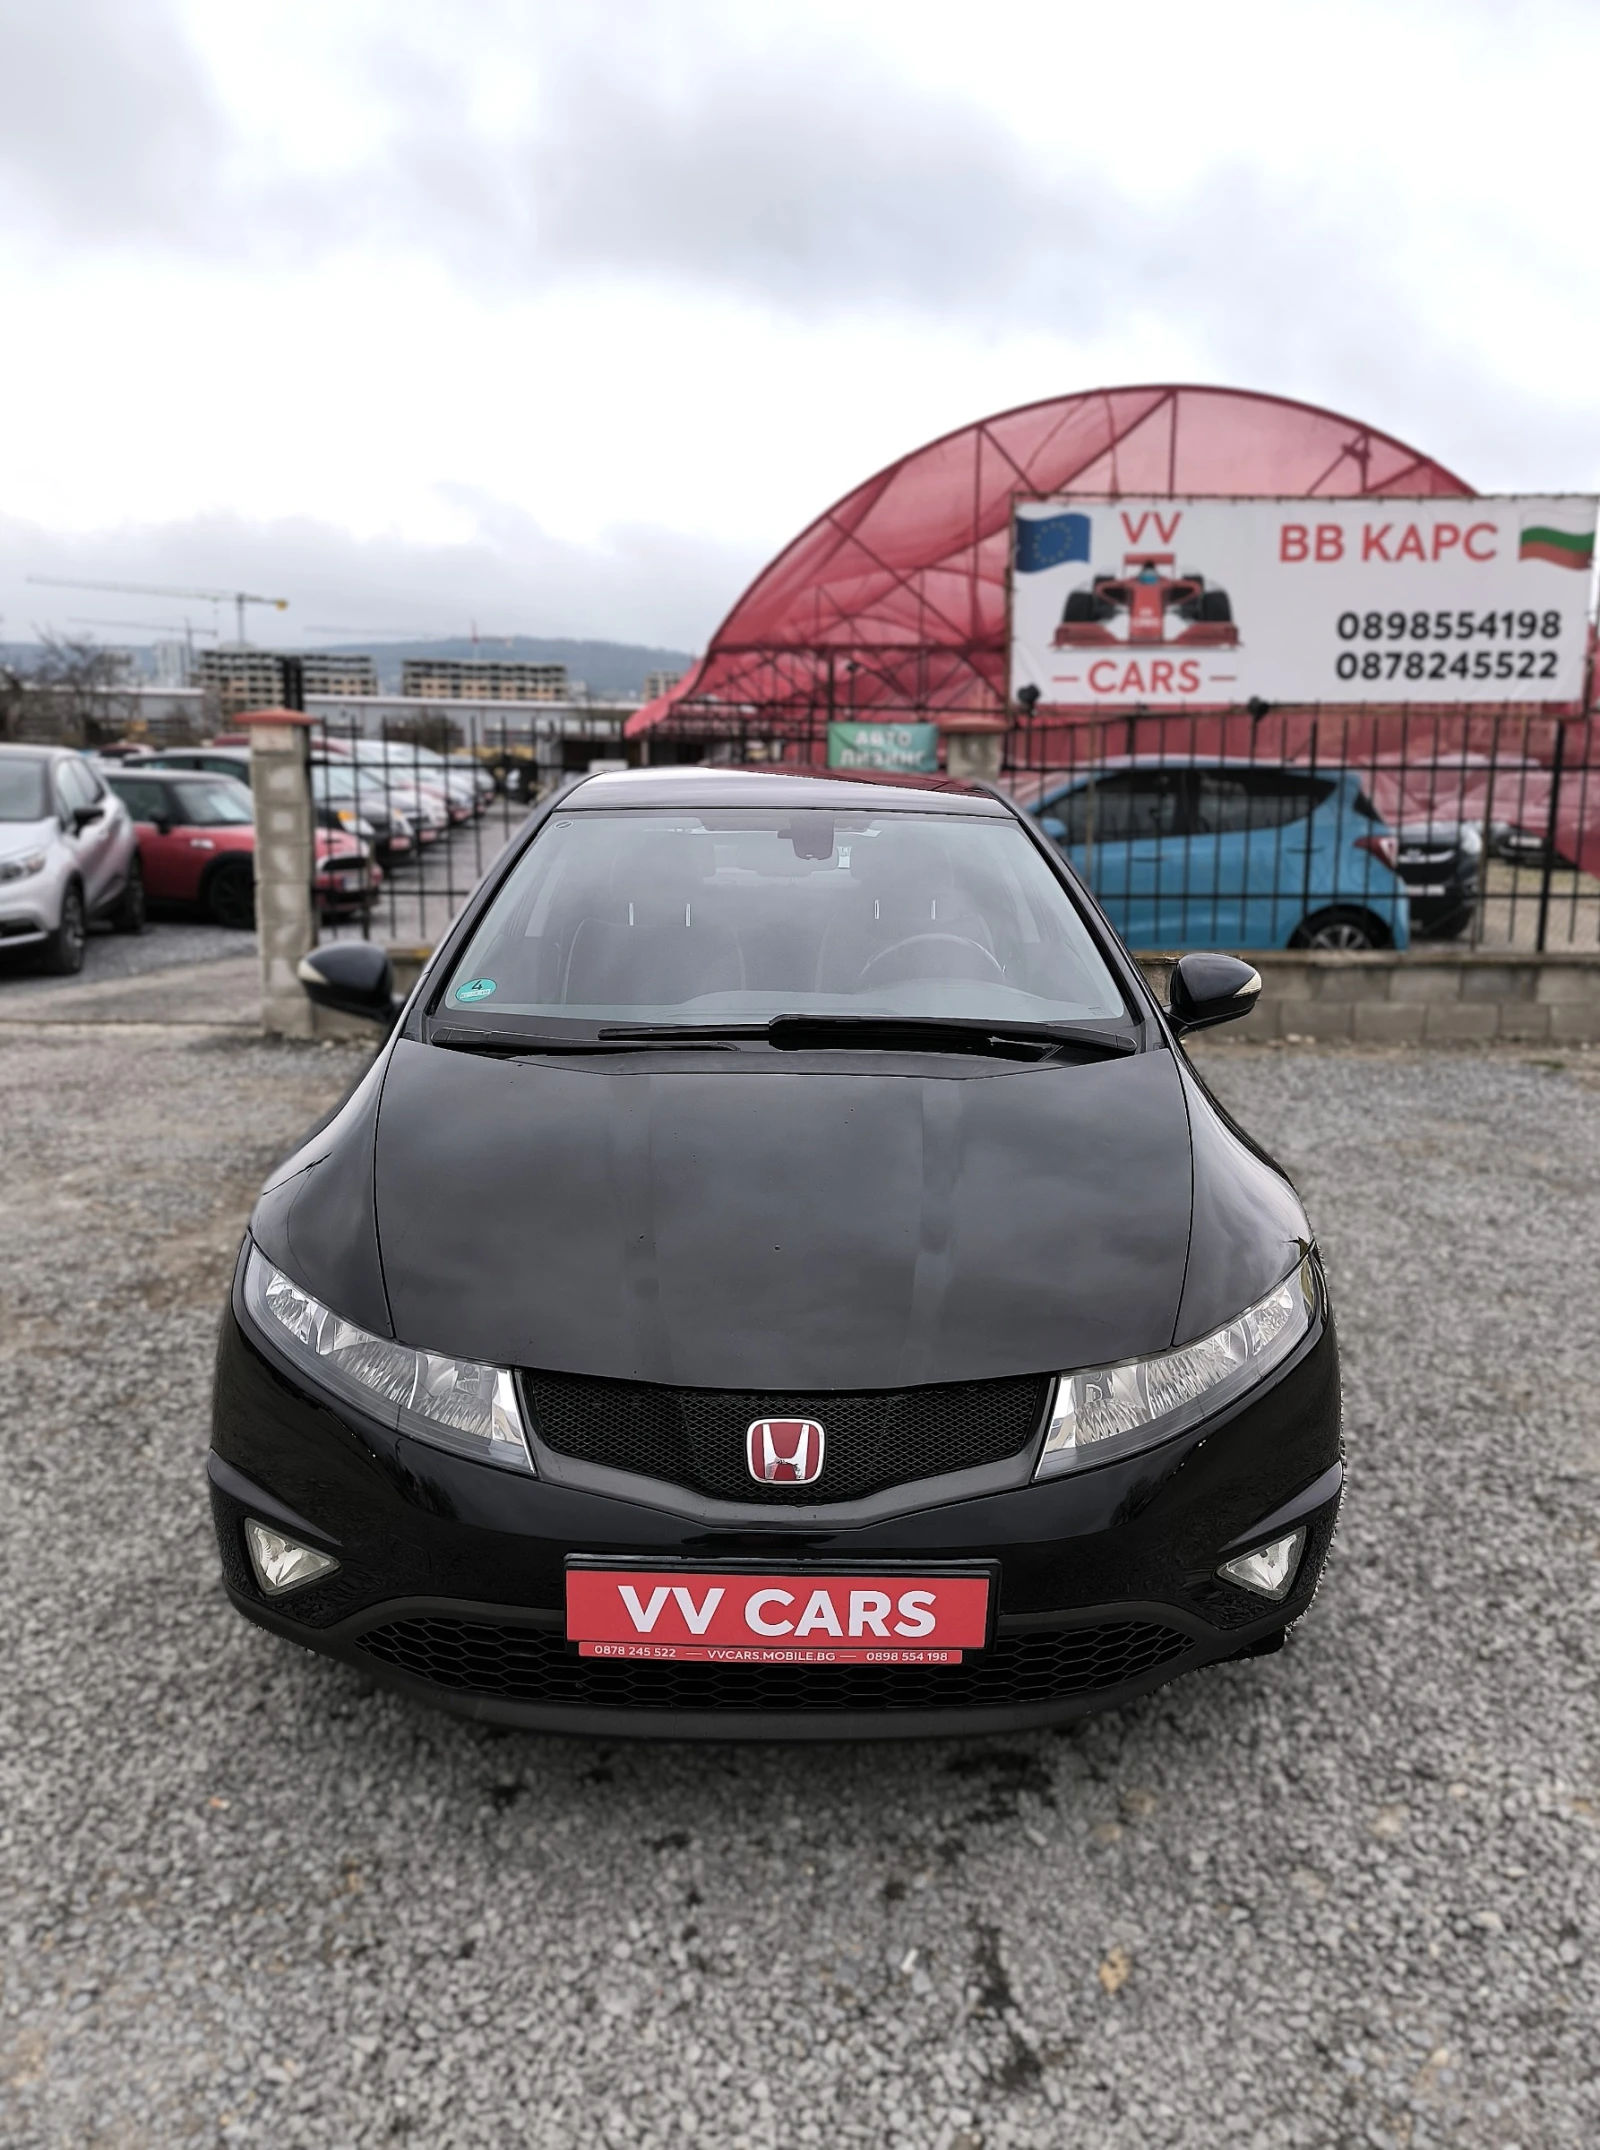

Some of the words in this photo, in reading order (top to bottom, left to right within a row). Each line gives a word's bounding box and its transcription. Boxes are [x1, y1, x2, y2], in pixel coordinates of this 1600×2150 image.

[1120, 511, 1182, 544] VV
[1279, 523, 1344, 562] ВВ
[1361, 522, 1498, 563] КАРС
[1336, 610, 1561, 641] 0898554198
[1087, 659, 1200, 695] CARS
[1335, 650, 1558, 681] 0878245522
[854, 728, 912, 748] АВТО
[471, 979, 483, 990] 4
[617, 1585, 726, 1635] VV
[744, 1588, 937, 1638] CARS
[594, 1645, 625, 1656] 0878
[628, 1646, 651, 1657] 245
[653, 1648, 676, 1658] 522
[707, 1649, 836, 1662] VVCARS.MOBILE.BG
[865, 1651, 898, 1661] 0898
[901, 1652, 924, 1662] 554
[926, 1652, 948, 1662] 198
